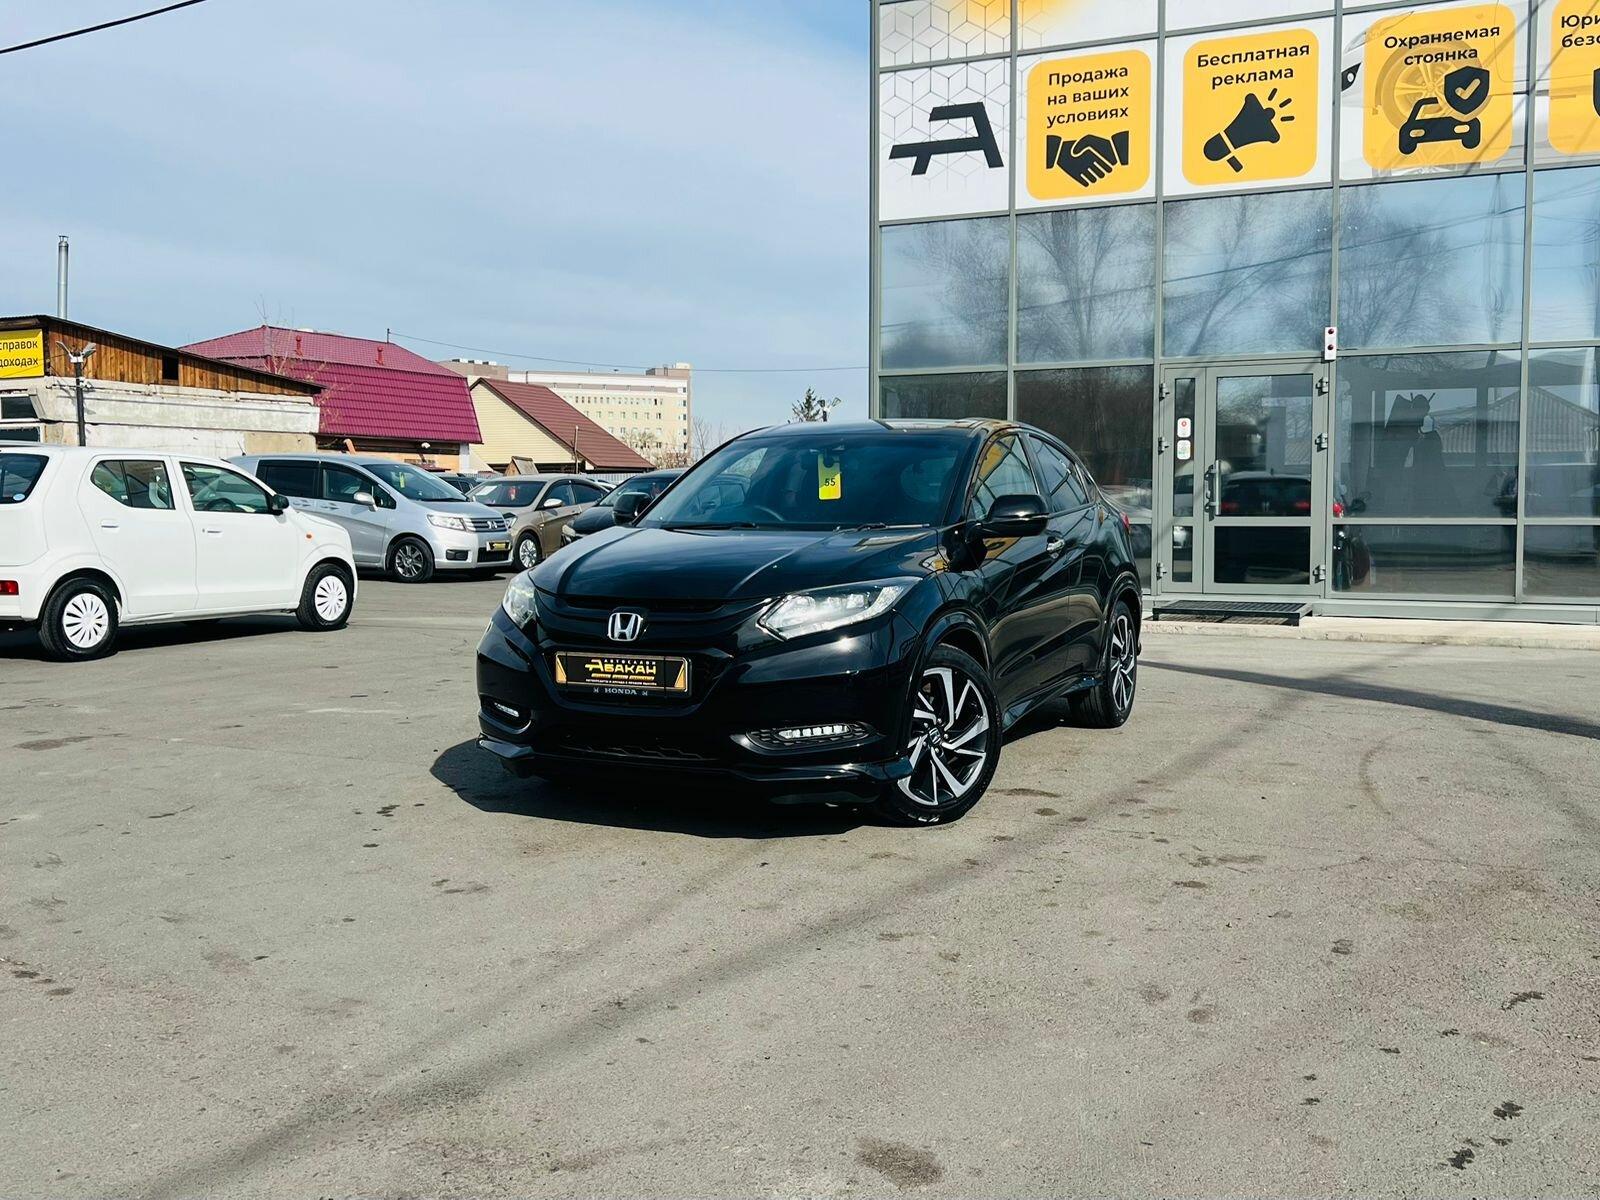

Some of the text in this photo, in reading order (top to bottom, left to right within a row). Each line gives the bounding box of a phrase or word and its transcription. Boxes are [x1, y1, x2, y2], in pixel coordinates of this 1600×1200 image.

[1384, 26, 1500, 49] Охраняемая
[1197, 44, 1310, 68] Бесплатная
[1404, 48, 1478, 66] стоянка
[1048, 66, 1129, 87] Продажа
[1211, 67, 1294, 90] реклама
[1047, 86, 1130, 106] на ваших
[1046, 106, 1129, 129] условиях
[824, 477, 836, 487] 55
[604, 687, 638, 696] HONDA
